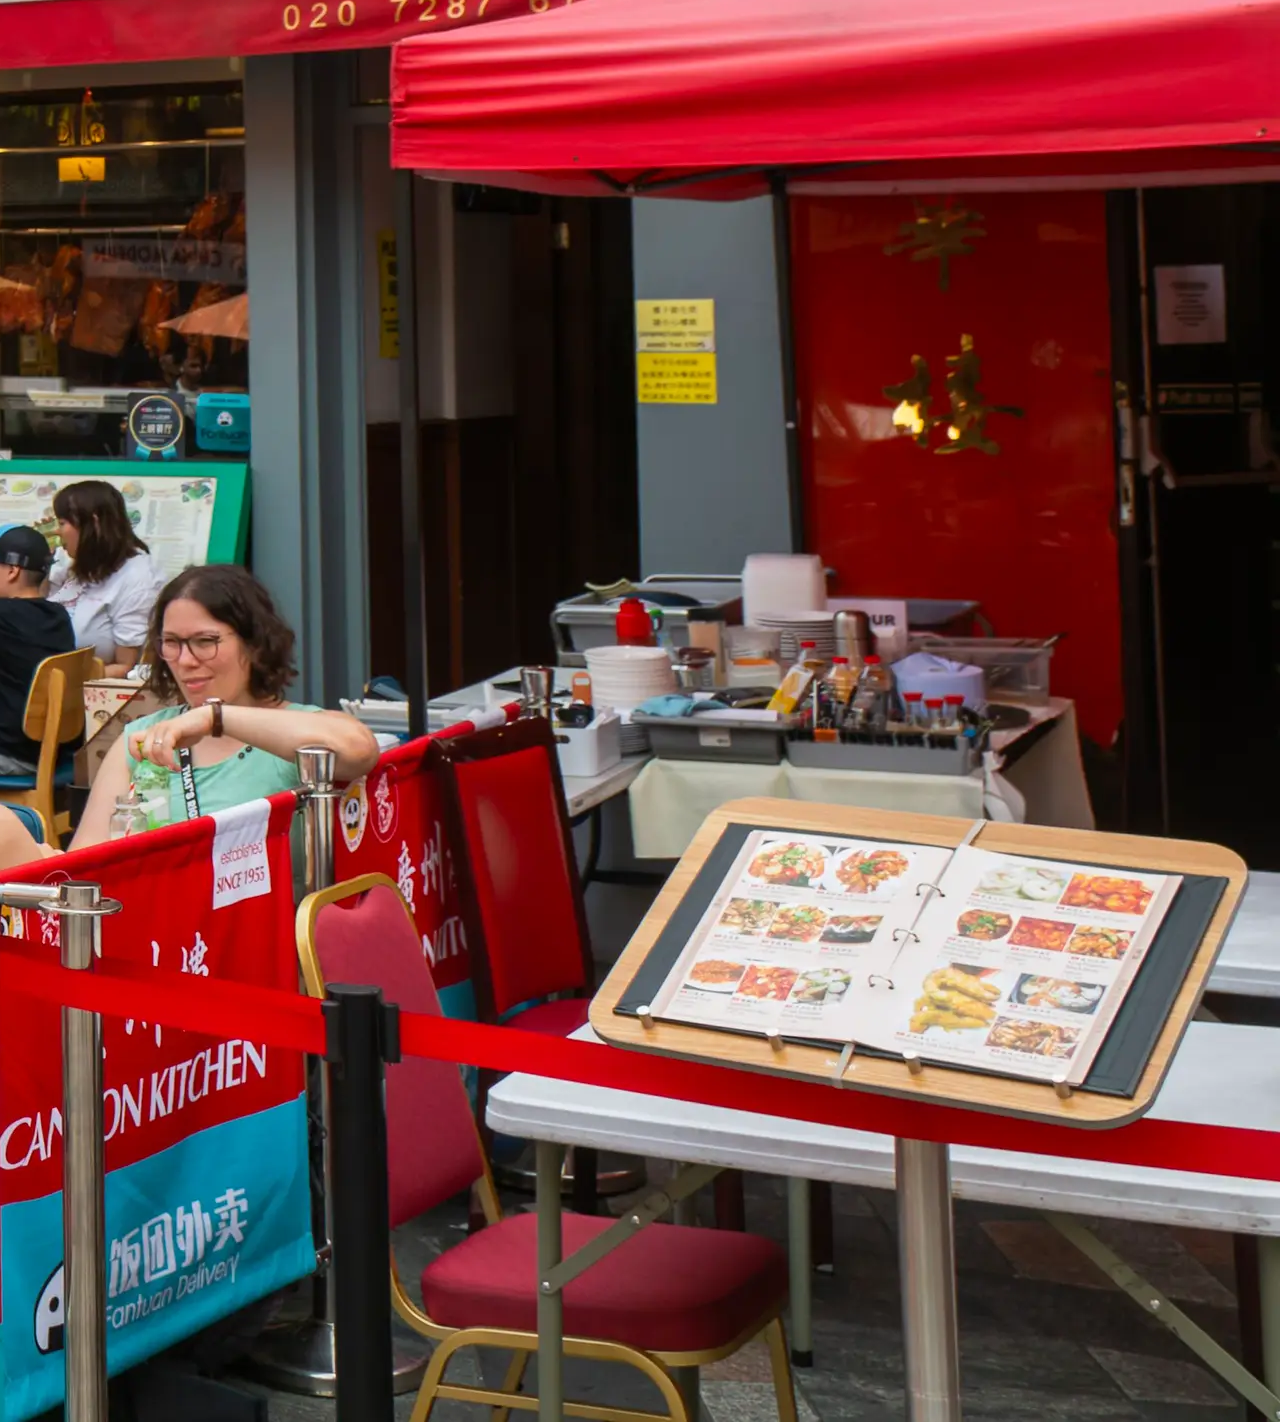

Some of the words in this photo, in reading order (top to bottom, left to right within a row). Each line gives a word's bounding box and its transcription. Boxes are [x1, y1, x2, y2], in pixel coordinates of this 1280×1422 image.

[282, 0, 357, 31] 020
[220, 837, 264, 865] established
[243, 865, 266, 887] 1955
[148, 1038, 267, 1123] KITCHEN
[108, 1186, 249, 1299] 饭团外卖
[175, 1251, 242, 1305] Delivery
